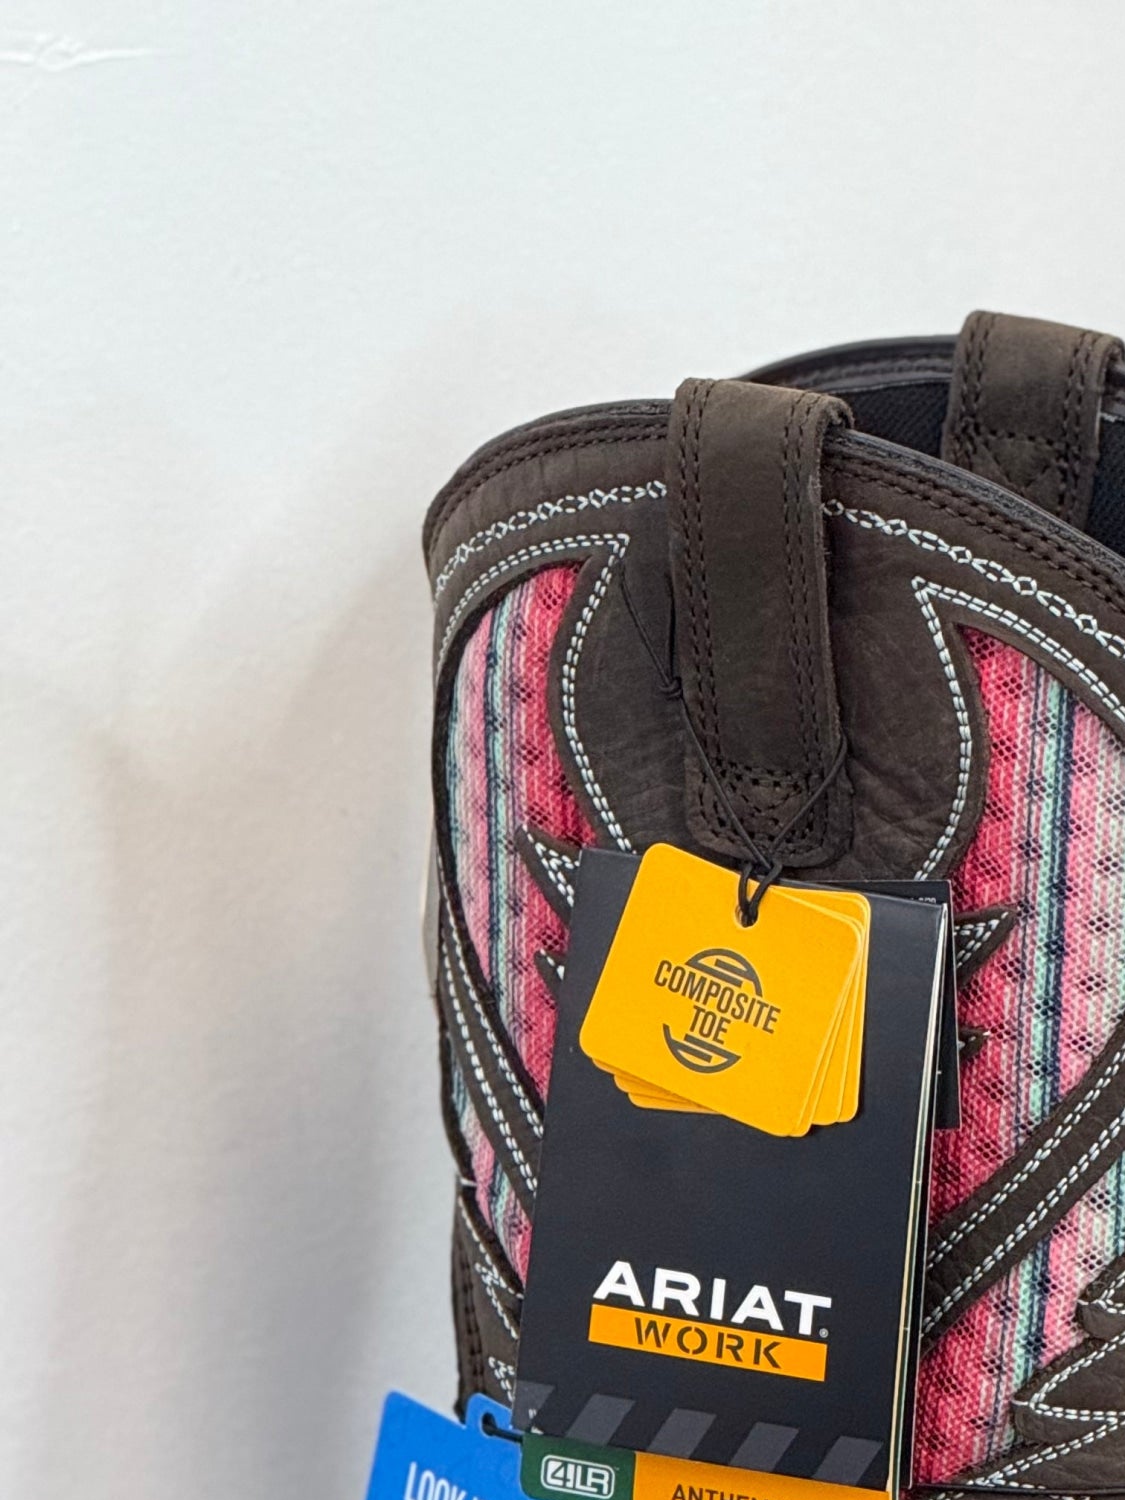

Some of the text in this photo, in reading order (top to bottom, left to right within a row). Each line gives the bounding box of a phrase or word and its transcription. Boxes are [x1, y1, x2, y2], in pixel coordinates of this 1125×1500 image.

[654, 959, 781, 1035] COMPOSITE
[689, 1005, 732, 1045] TOE
[593, 1260, 832, 1336] ARIAT
[634, 1317, 782, 1370] WORK
[546, 1460, 610, 1496] 4LR
